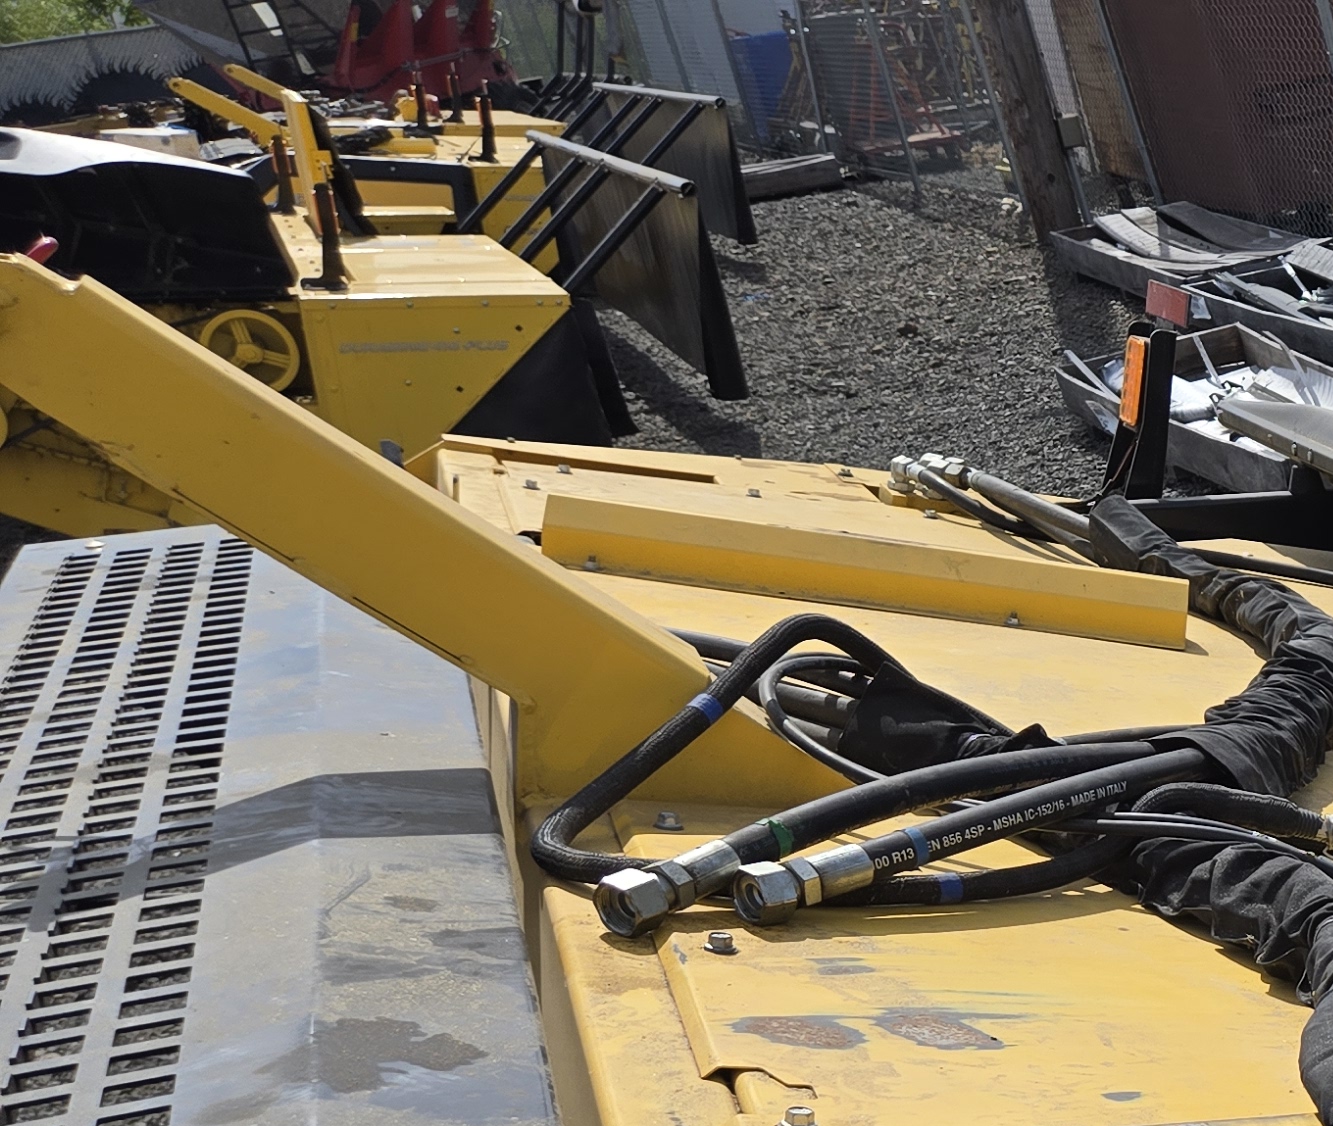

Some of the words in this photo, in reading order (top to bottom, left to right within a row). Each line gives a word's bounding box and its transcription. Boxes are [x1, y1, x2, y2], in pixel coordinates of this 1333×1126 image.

[874, 855, 890, 870] 00
[891, 847, 915, 864] R13
[942, 831, 963, 848] 856
[964, 824, 985, 840] 4SP
[993, 812, 1024, 831] MSHA
[1025, 799, 1064, 821] IC-152/16
[1071, 789, 1096, 806] MADE
[1096, 786, 1106, 799] IN
[1106, 781, 1127, 797] ITALY
